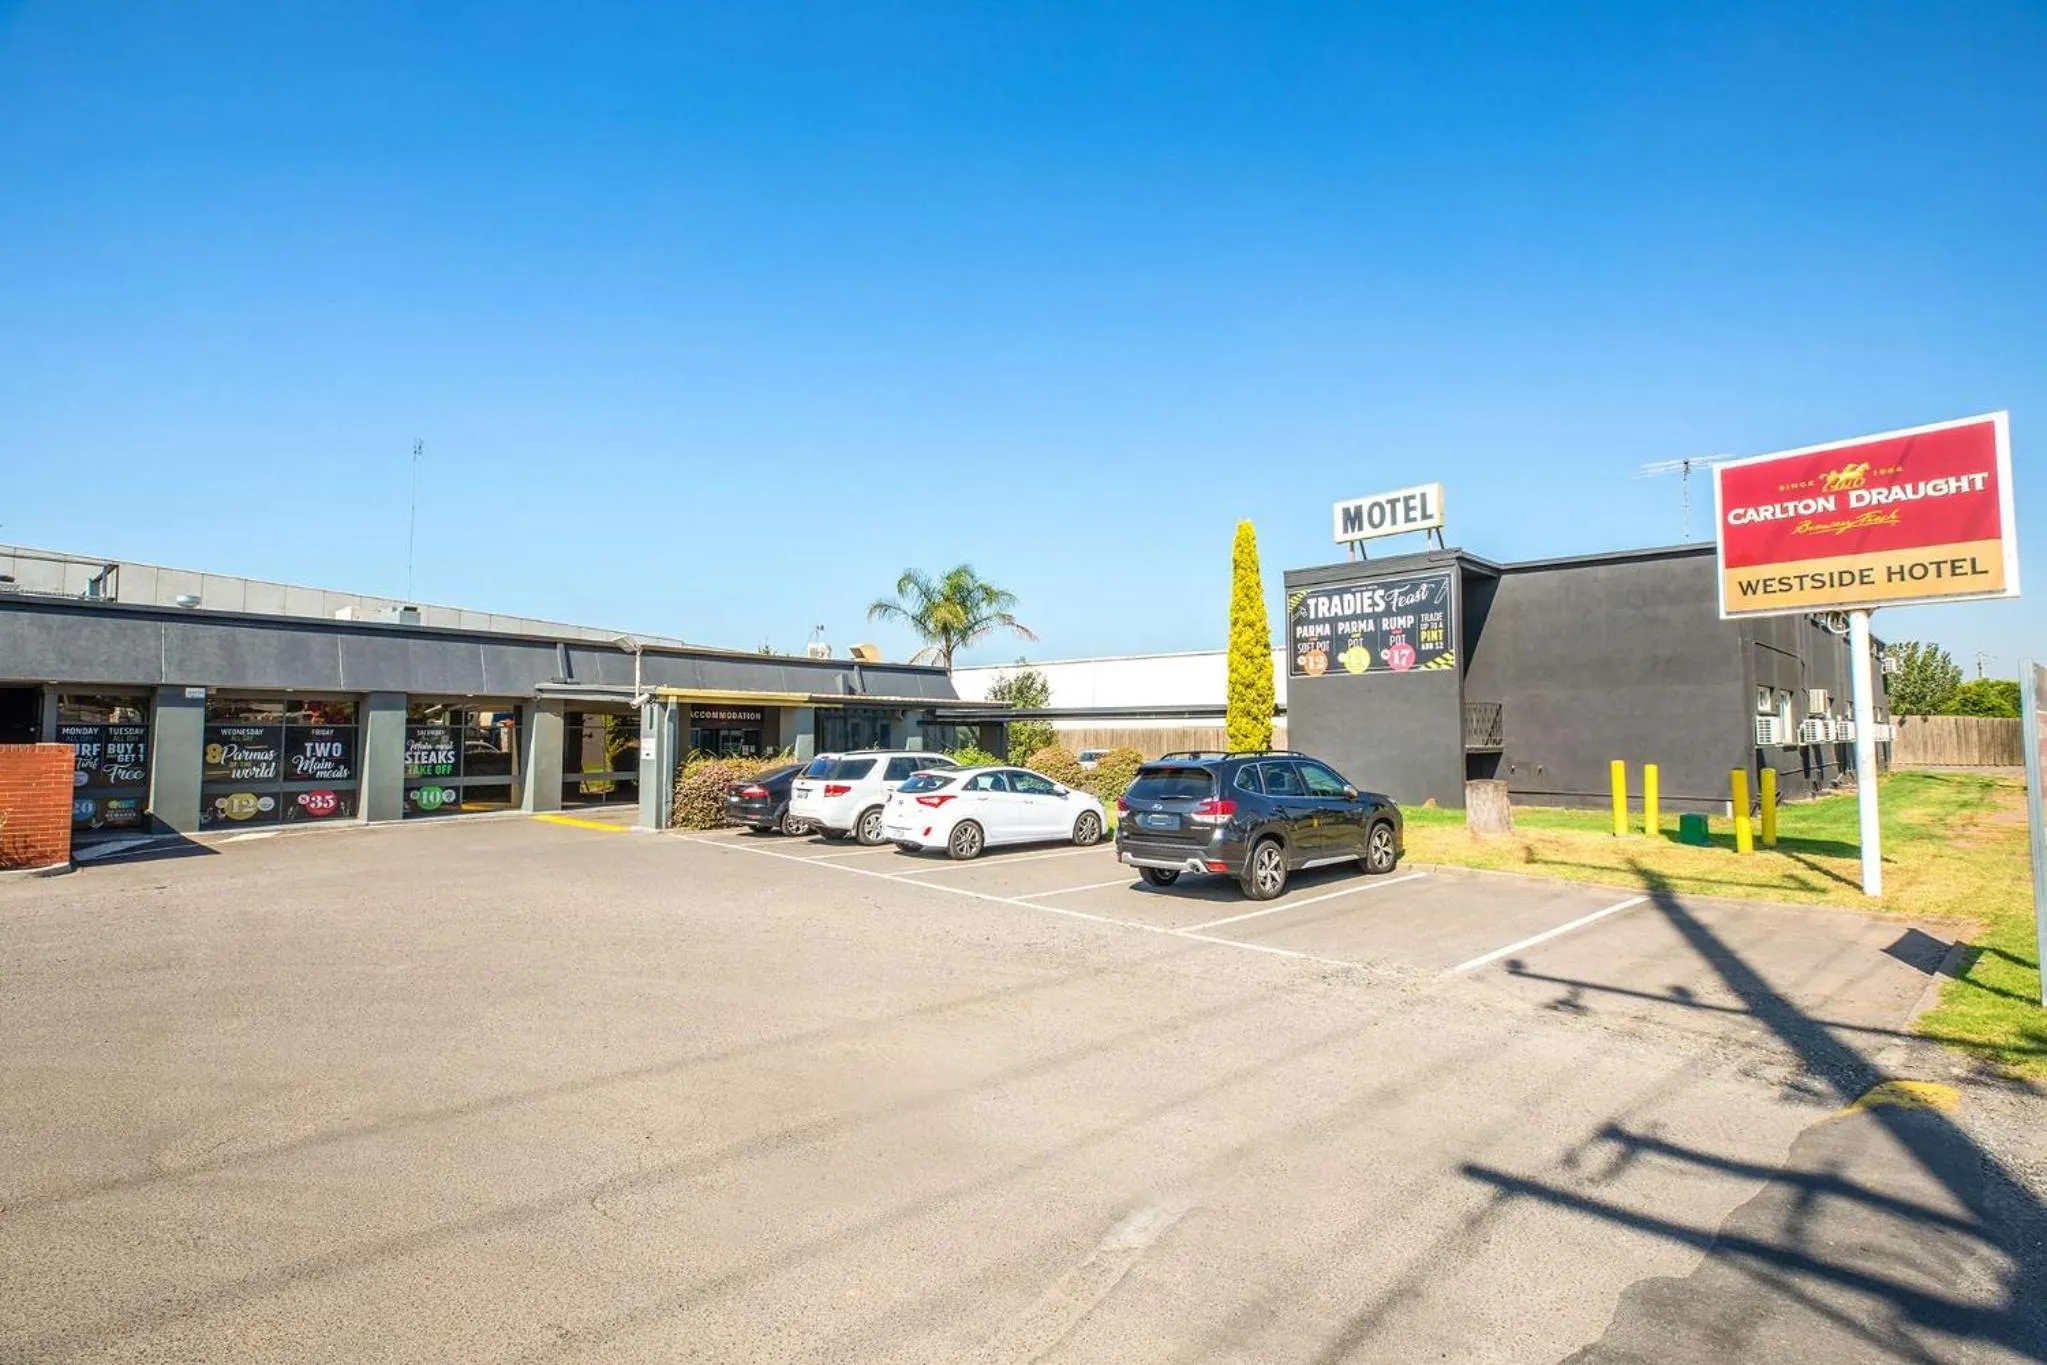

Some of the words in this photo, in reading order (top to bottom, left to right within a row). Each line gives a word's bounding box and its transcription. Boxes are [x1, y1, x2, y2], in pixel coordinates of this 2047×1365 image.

[1727, 495, 1836, 525] CARLTON
[1849, 471, 1989, 509] DRAUGHT
[1342, 492, 1434, 535] MOTEL
[1738, 567, 1876, 597] WESTSIDE
[1886, 557, 1989, 584] HOTEL
[1306, 588, 1385, 620] TRADIES
[1384, 583, 1435, 612] Feast
[1337, 619, 1376, 635] PARMA
[1382, 615, 1415, 631] RUMP
[1296, 623, 1331, 639] PARMA
[1420, 629, 1445, 642] PINT
[1347, 638, 1364, 648] POT
[1389, 634, 1406, 646] POT
[62, 727, 99, 735] MONDAY
[109, 727, 144, 735] TUESDAY
[220, 728, 264, 736] WEDNESDAY
[75, 744, 101, 757] RF
[107, 743, 134, 754] BUY
[138, 743, 145, 754] 1
[206, 743, 222, 764] 8
[220, 744, 277, 765] Parmas
[304, 742, 342, 757] TWO
[116, 755, 136, 763] GET
[404, 751, 455, 764] STEAKS
[232, 762, 277, 779] world
[291, 755, 335, 775] Main
[315, 765, 350, 778] meals
[409, 765, 433, 775] TAKE
[435, 764, 453, 775] OFF
[103, 763, 145, 784] Free
